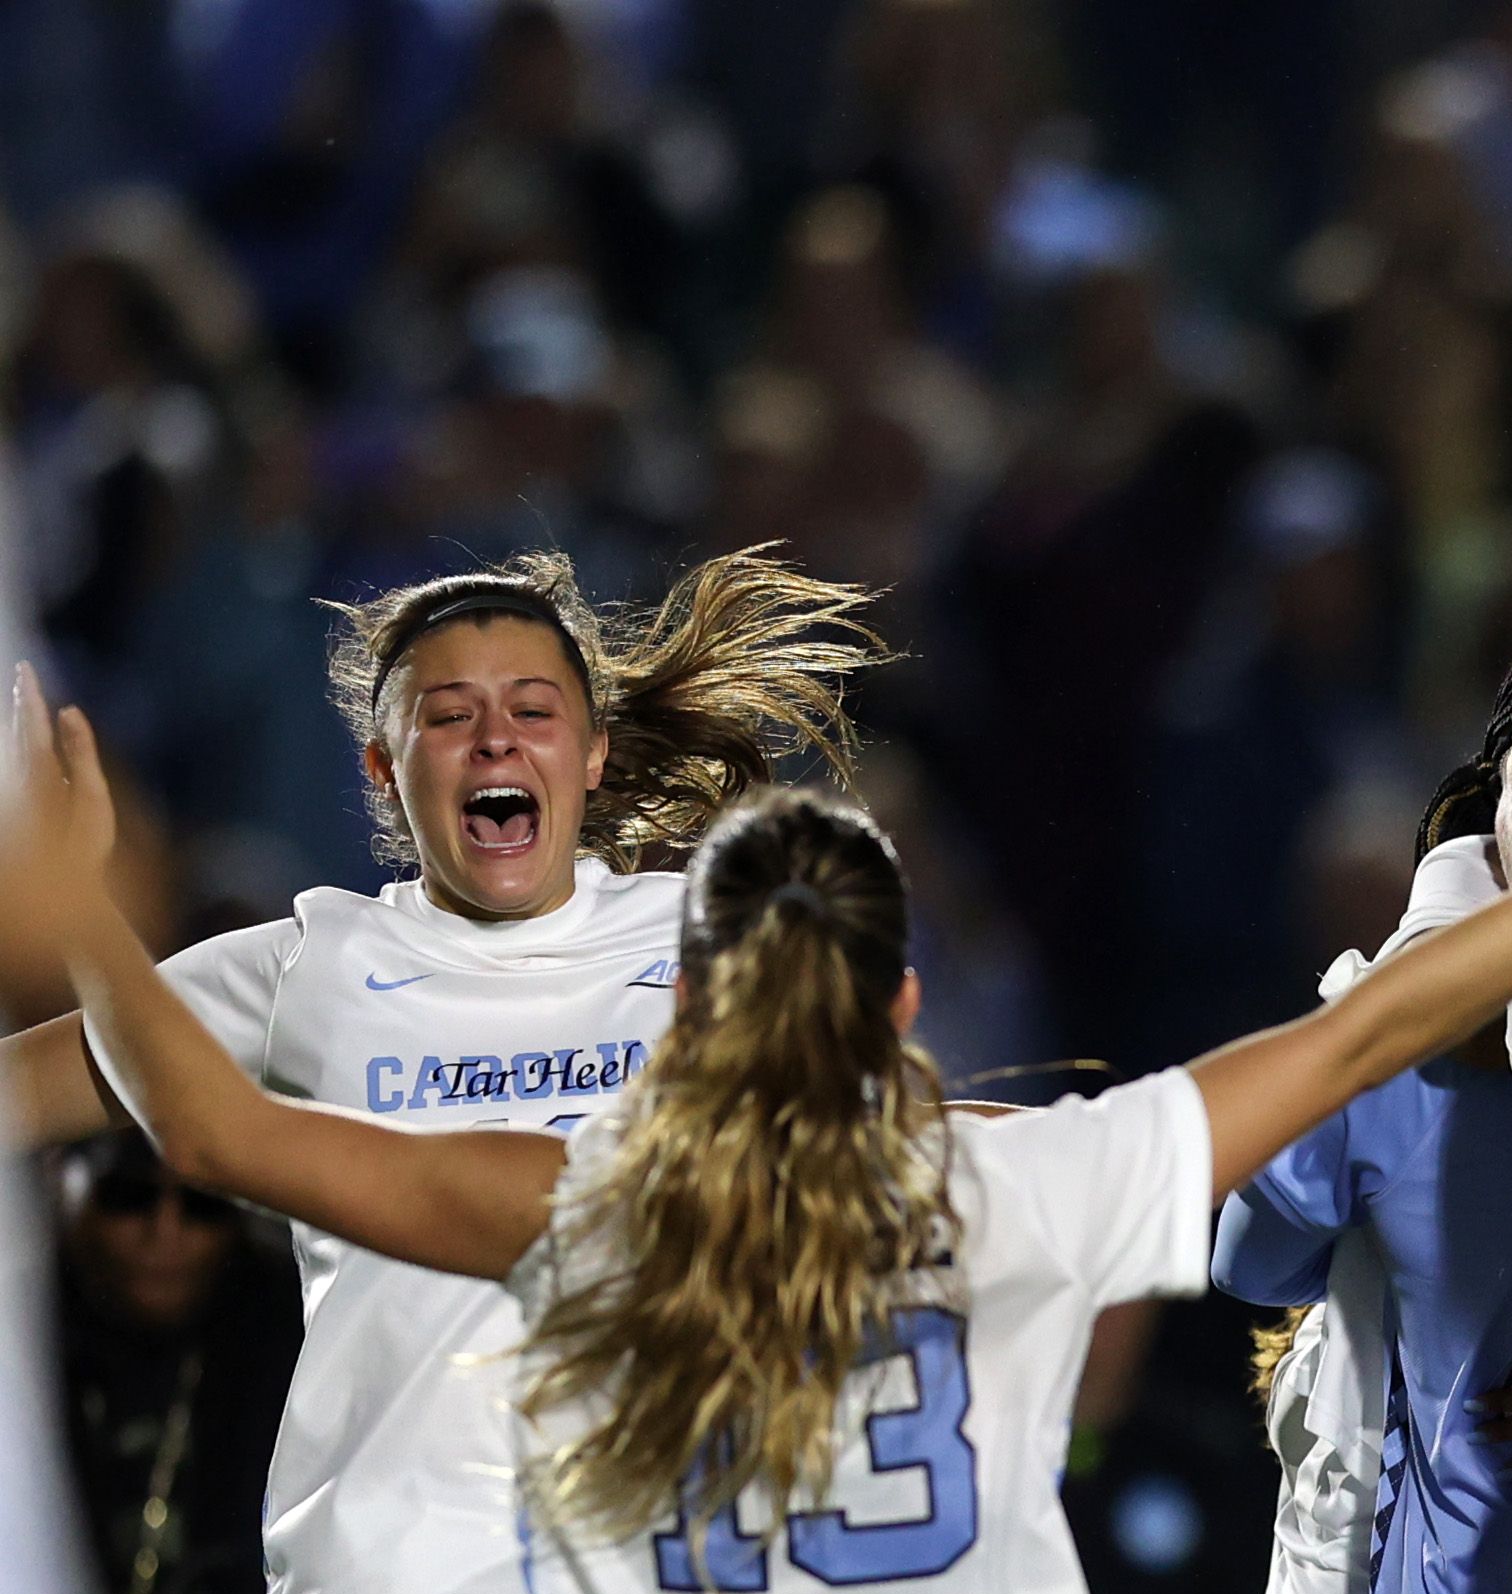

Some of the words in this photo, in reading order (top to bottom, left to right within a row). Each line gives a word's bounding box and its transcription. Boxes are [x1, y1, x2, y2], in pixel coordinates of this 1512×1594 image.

[636, 958, 681, 984] AC
[365, 1039, 653, 1113] CAROLIN
[432, 1058, 519, 1100] Tar
